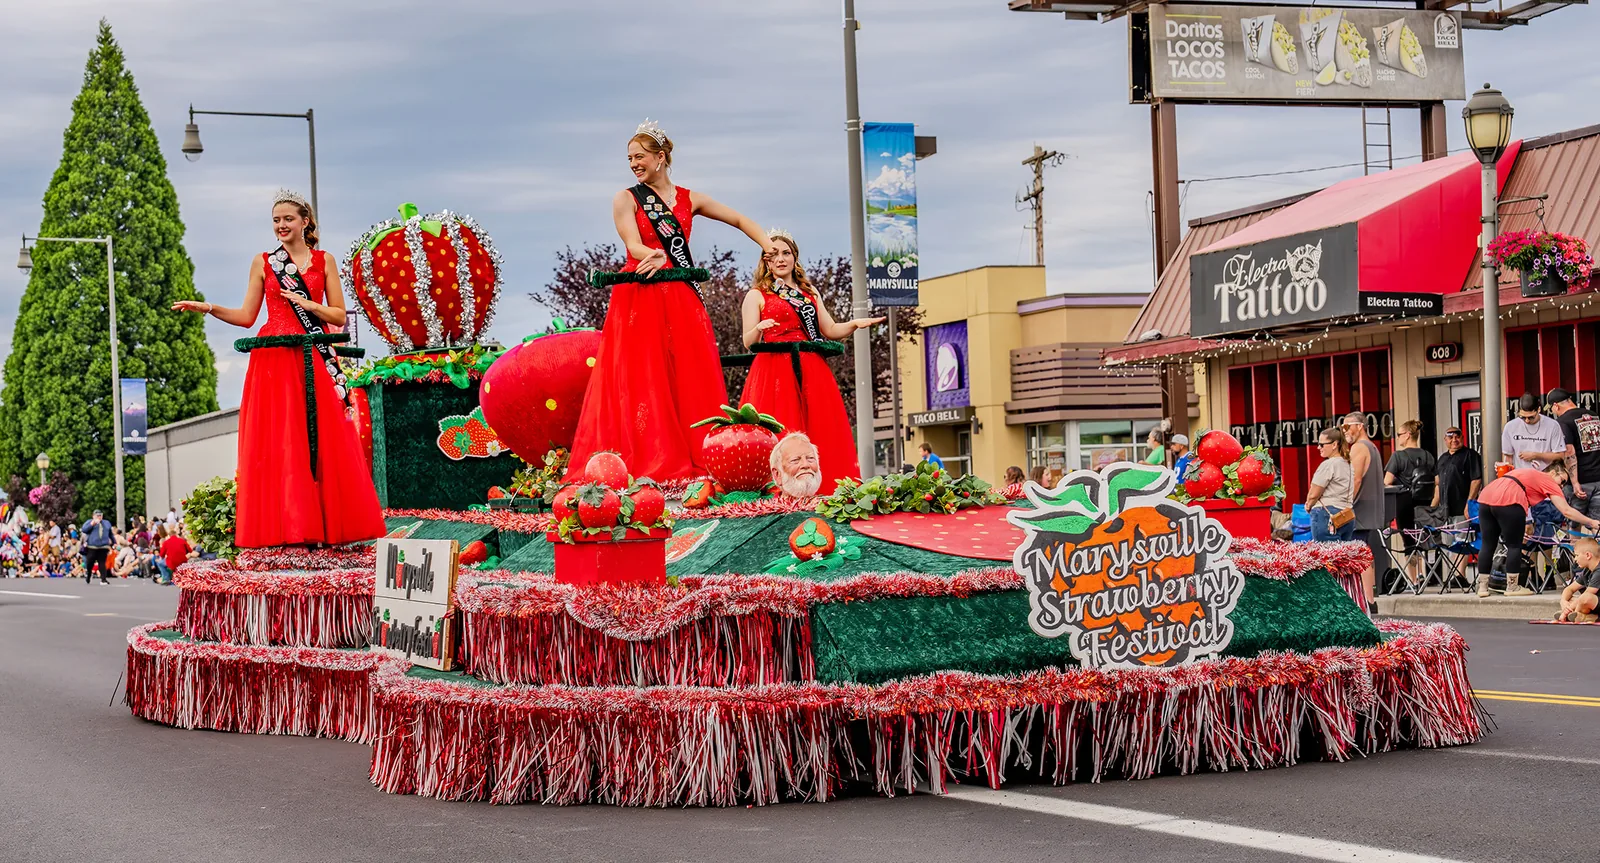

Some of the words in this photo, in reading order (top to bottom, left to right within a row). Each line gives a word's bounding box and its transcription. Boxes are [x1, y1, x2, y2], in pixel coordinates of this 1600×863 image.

[1165, 20, 1223, 39] Doritos
[1166, 40, 1225, 58] LOCOS
[1168, 60, 1226, 79] TACOS
[1296, 88, 1317, 96] FIERY
[1222, 251, 1290, 294] Electra
[869, 278, 918, 290] MARYSVILLE
[1214, 273, 1327, 323] Tattoo
[1367, 296, 1400, 308] Electra
[1402, 297, 1434, 309] Tattoo
[1431, 346, 1450, 360] 608
[912, 412, 936, 424] TACO
[936, 410, 960, 421] BELL
[1025, 515, 1227, 580] Marysville
[386, 542, 435, 600] Mrysville
[1039, 565, 1239, 627] Strawberry
[1082, 602, 1228, 665] Festival
